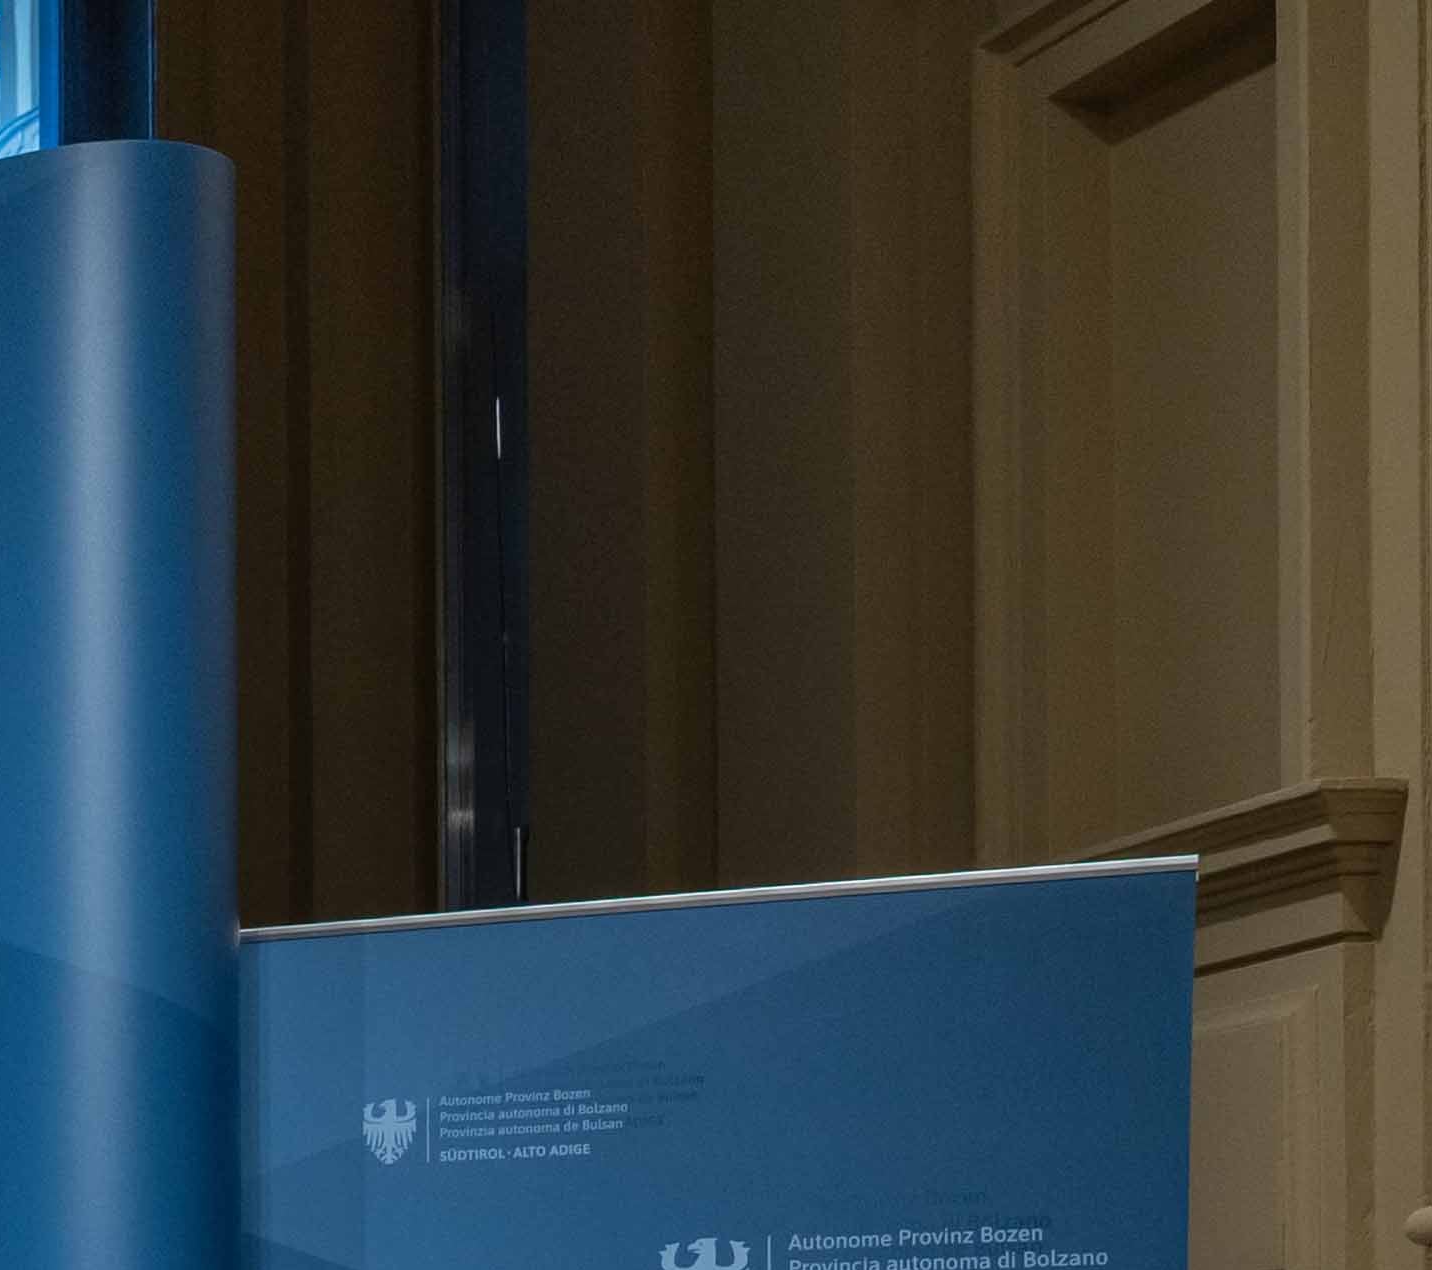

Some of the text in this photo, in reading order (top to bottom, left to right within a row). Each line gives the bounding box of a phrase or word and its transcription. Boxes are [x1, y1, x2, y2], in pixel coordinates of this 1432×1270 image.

[788, 1227, 1043, 1250] Autonome Provinz Bozen
[998, 1251, 1015, 1268] di
[1024, 1250, 1108, 1268] Bolzano
